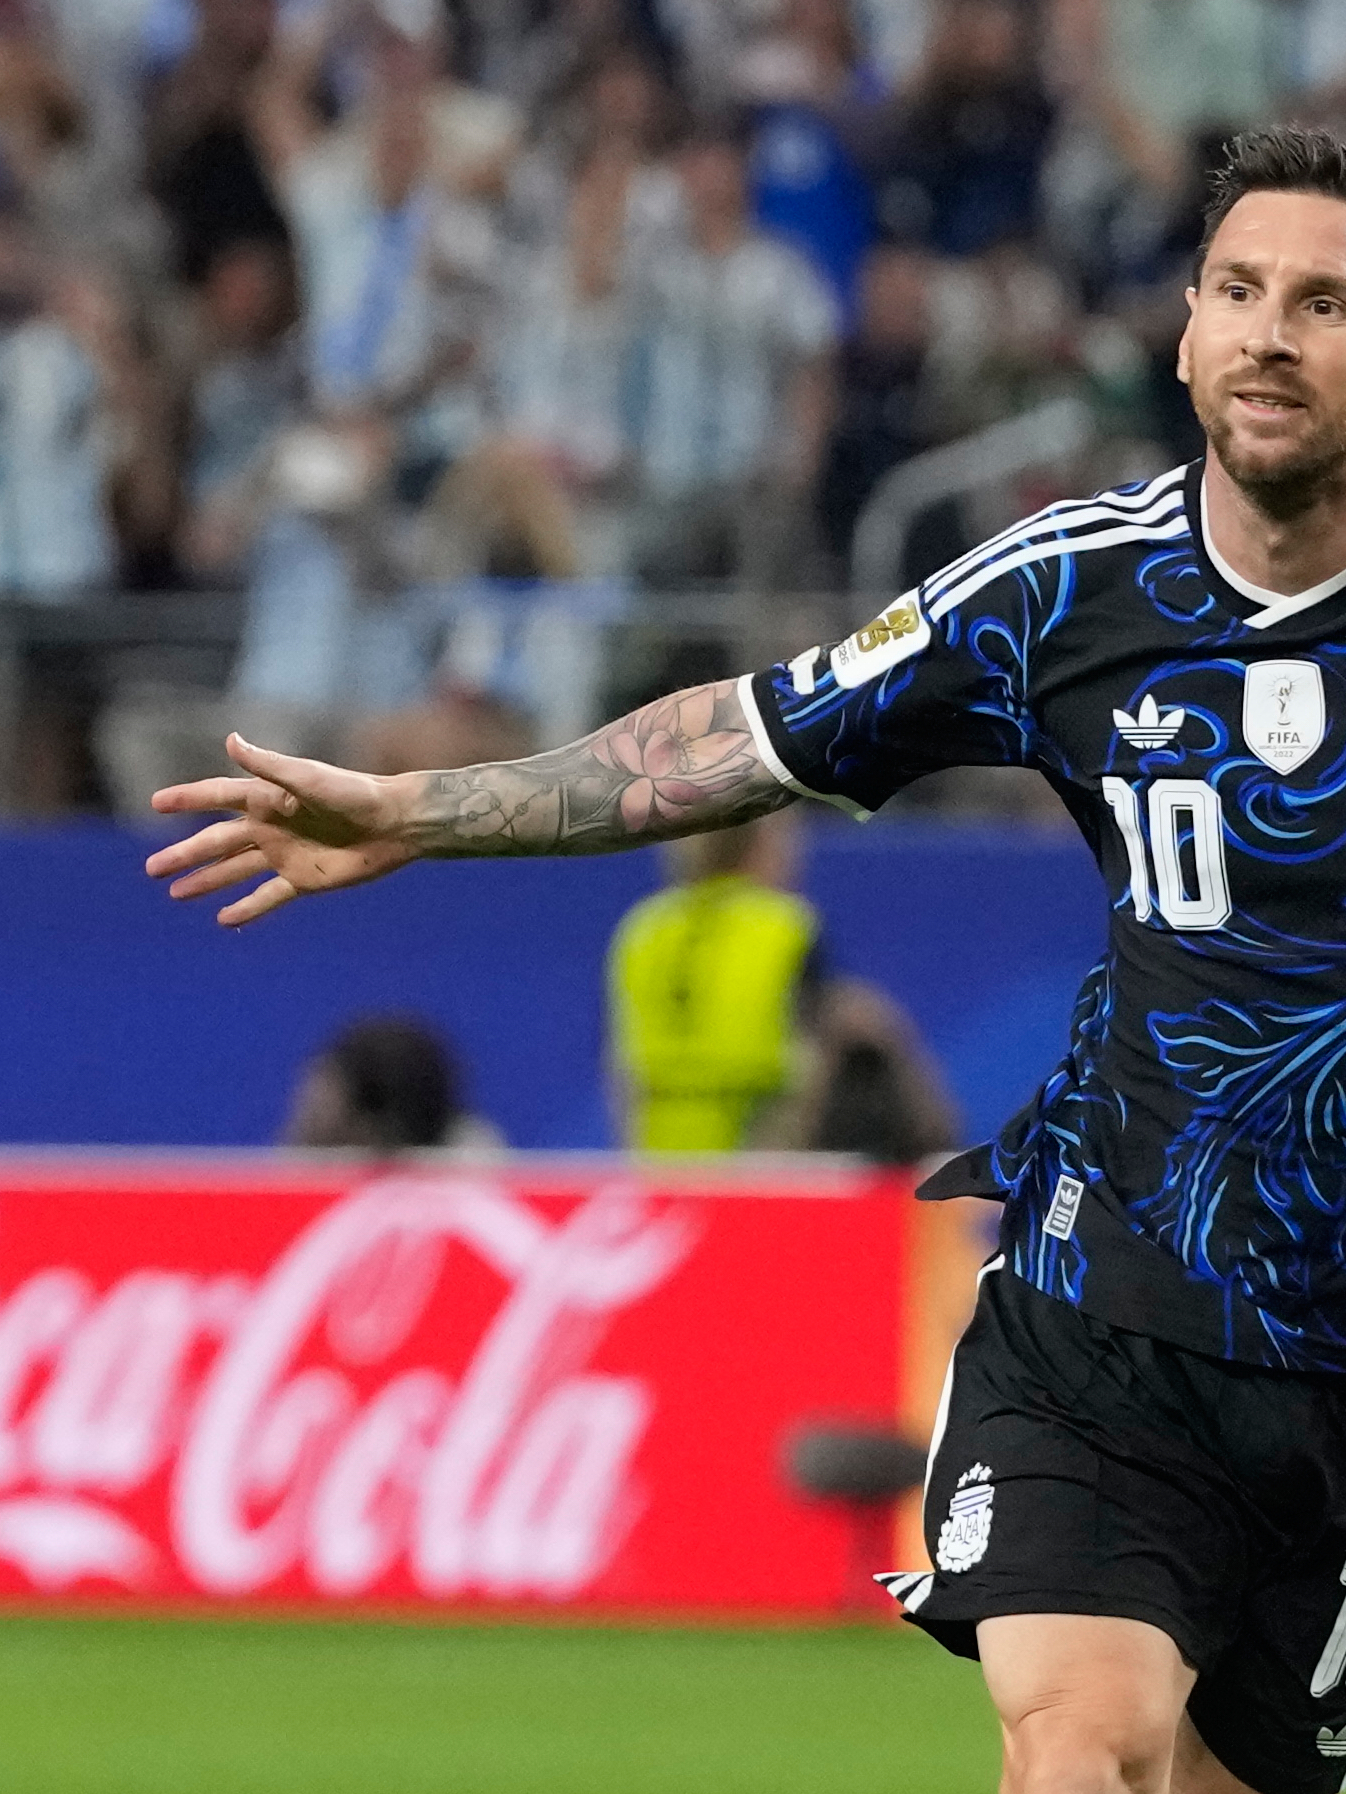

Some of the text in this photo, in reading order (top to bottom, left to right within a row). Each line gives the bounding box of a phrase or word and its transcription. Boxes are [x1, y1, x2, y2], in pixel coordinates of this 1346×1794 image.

[1267, 732, 1301, 744] FIFA
[1102, 776, 1233, 931] 10
[951, 1508, 979, 1546] AFA
